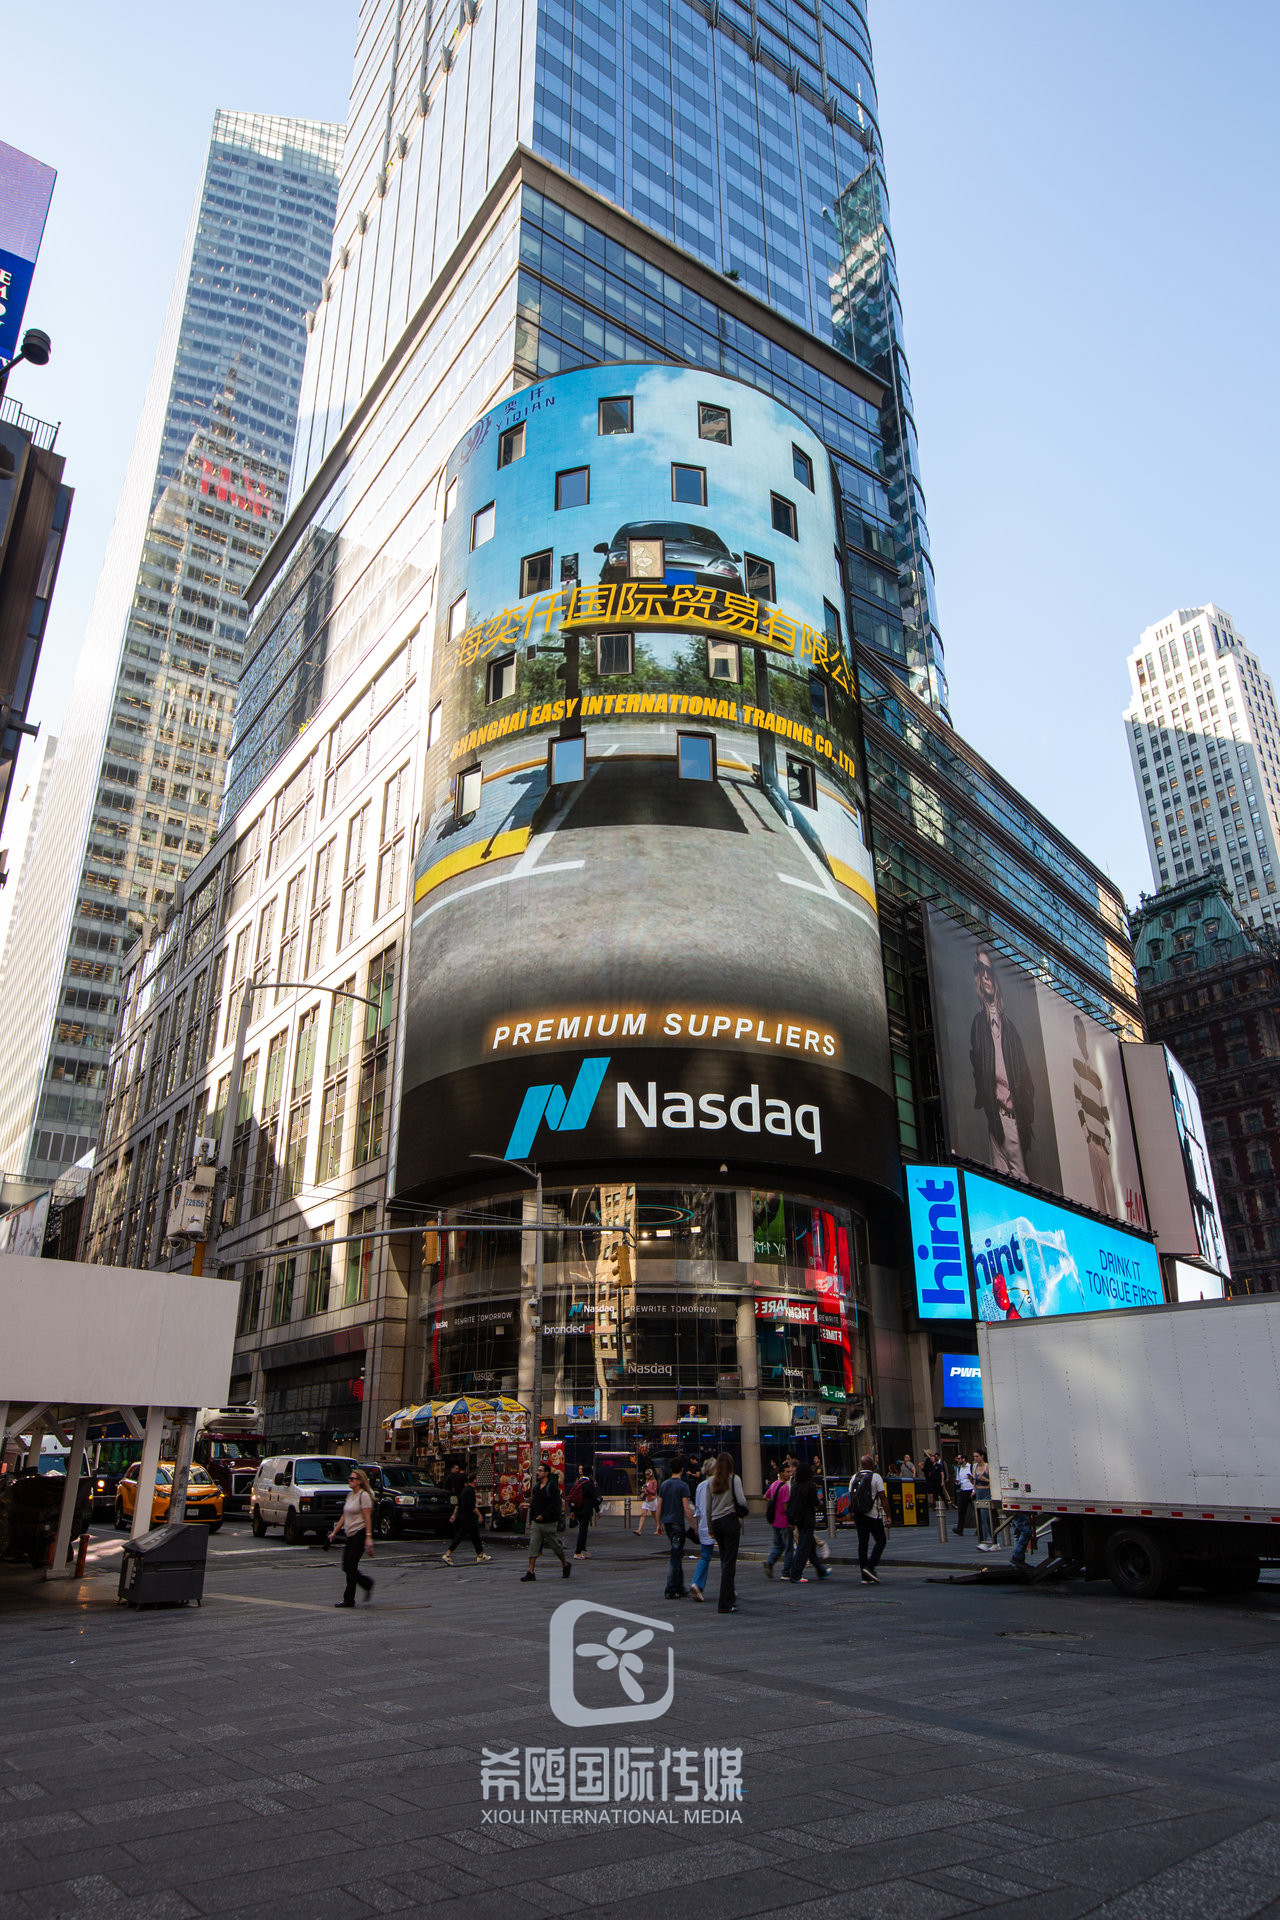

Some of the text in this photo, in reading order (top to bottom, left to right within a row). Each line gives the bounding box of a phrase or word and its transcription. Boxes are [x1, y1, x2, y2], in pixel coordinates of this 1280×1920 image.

[496, 396, 555, 431] YIQIAN
[451, 710, 527, 760] SHANGHAI
[530, 698, 579, 726] EASY
[580, 693, 738, 721] INTERNATIONAL
[742, 705, 813, 748] TRADING
[839, 750, 855, 779] LTD
[492, 1012, 835, 1057] PREMIUM SUPPLIERS
[616, 1081, 822, 1155] Nasdaq
[1125, 1187, 1144, 1228] H&M
[917, 1179, 965, 1304] hint
[1099, 1249, 1141, 1281] DRINK IT
[1086, 1270, 1158, 1306] TONGUE FIRST
[454, 1311, 513, 1326] REWRITE TOMORROW
[583, 1304, 615, 1314] Nasdaq
[630, 1305, 718, 1314] REWRITE TOMORROW
[628, 1362, 672, 1376] Nasdaq
